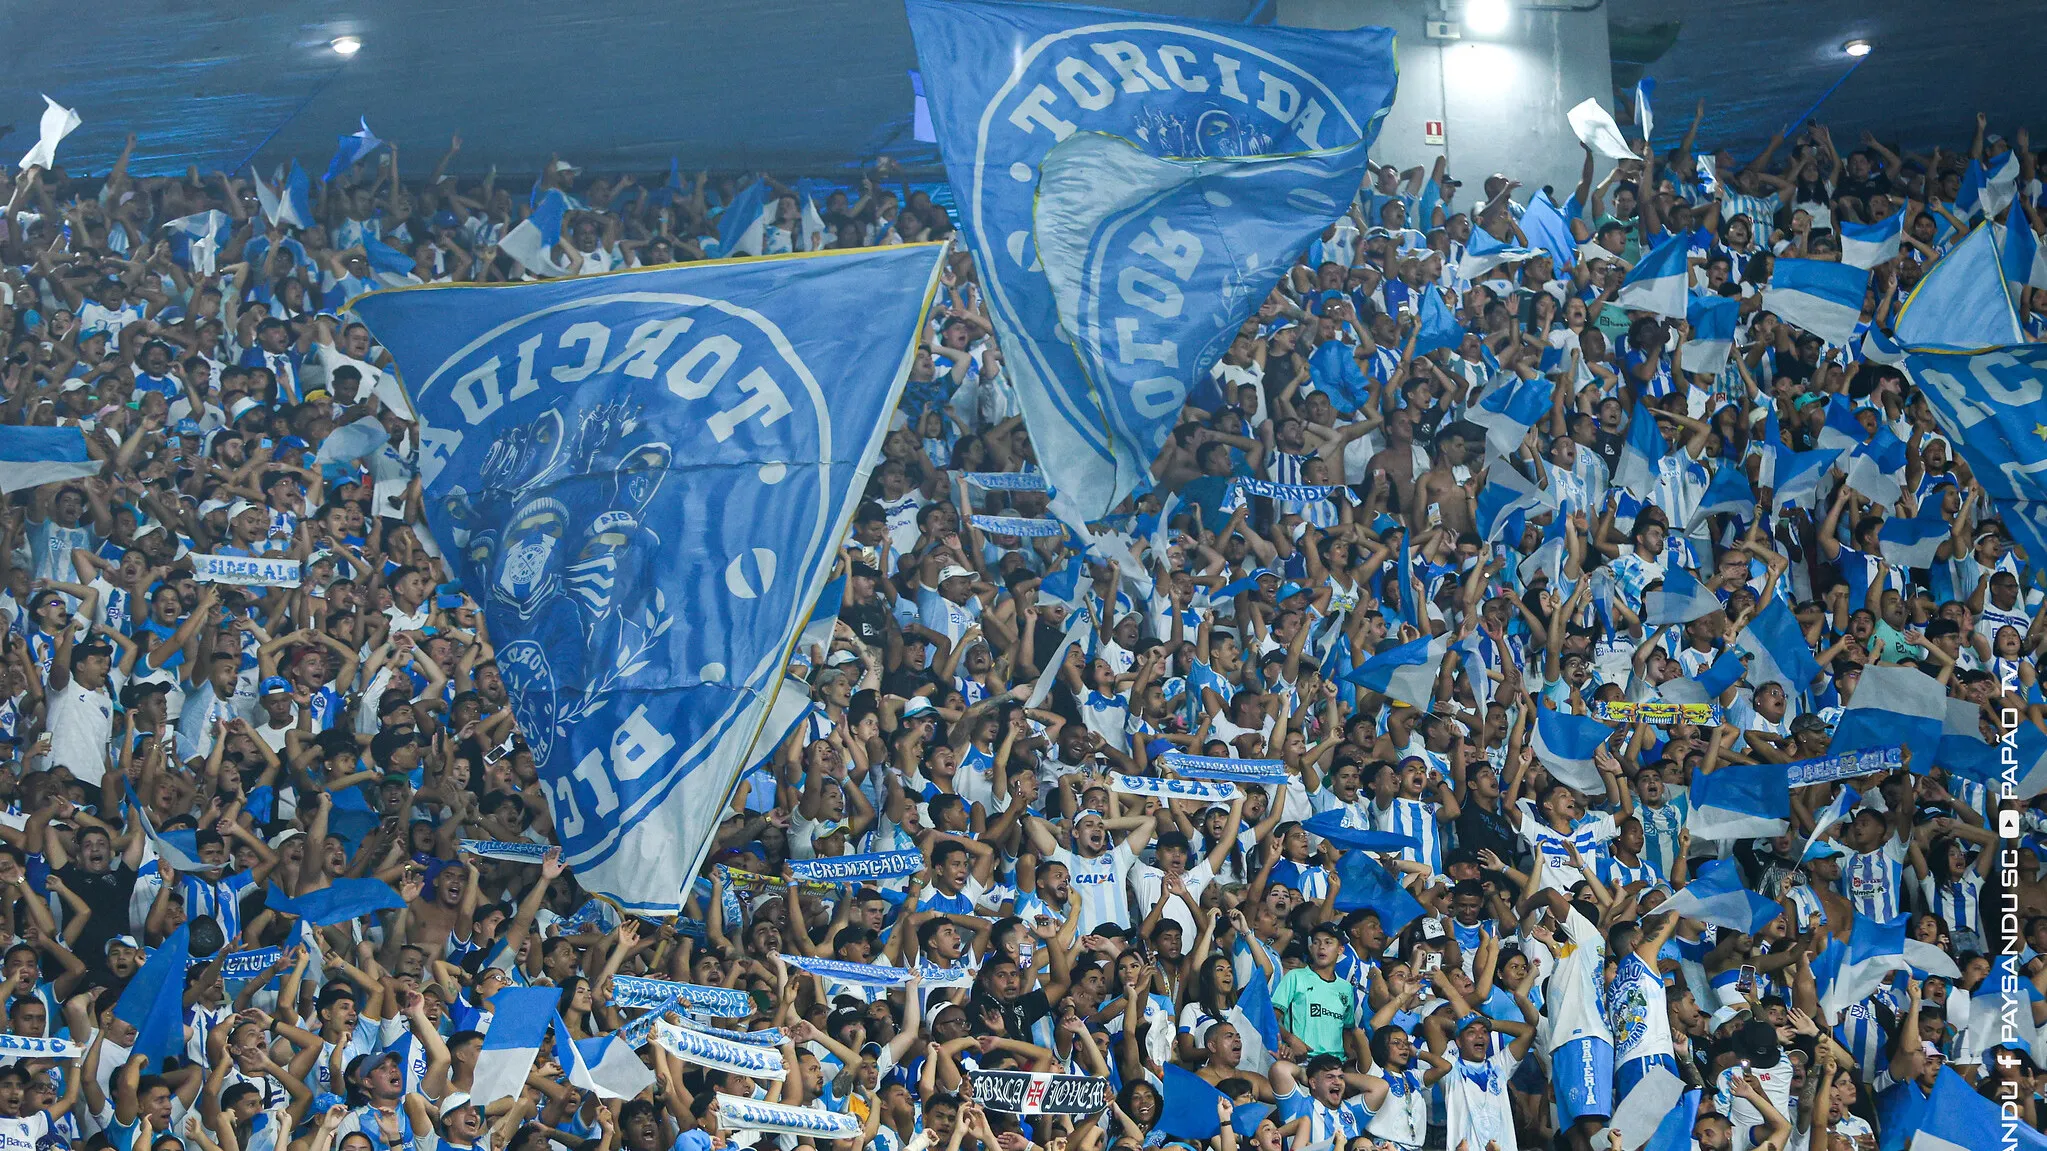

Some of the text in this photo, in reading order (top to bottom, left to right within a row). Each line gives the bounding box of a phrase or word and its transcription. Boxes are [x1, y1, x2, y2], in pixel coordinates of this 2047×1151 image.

[1009, 40, 1328, 151] TORCIDA
[809, 854, 904, 878] CREMAÇÃO
[1075, 873, 1115, 884] CAIXA
[1581, 1039, 1597, 1105] BATERIA
[973, 1075, 1105, 1110] FORÇA JOVEM
[743, 1104, 840, 1132] JURUNAS
